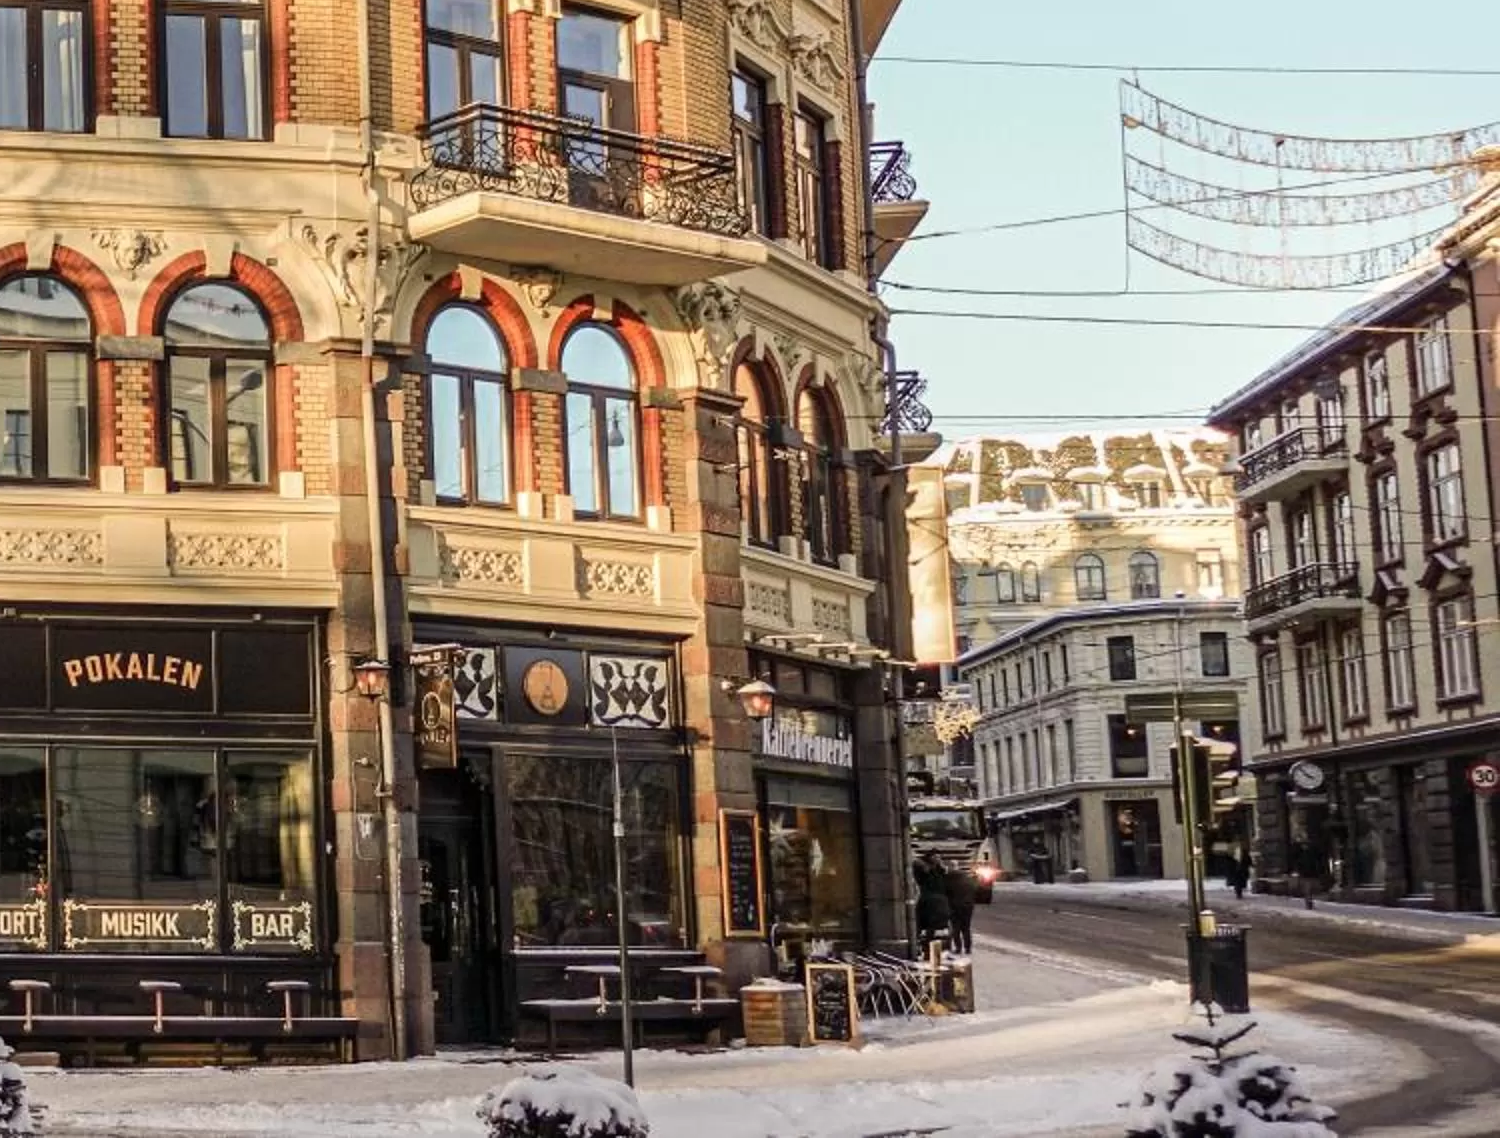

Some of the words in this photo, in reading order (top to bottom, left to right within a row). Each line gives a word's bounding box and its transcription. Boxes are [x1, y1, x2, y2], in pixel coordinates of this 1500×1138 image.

[63, 651, 203, 690] POKALEN
[1475, 769, 1495, 783] 30
[101, 912, 180, 937] MUSIKK
[251, 913, 294, 938] BAR
